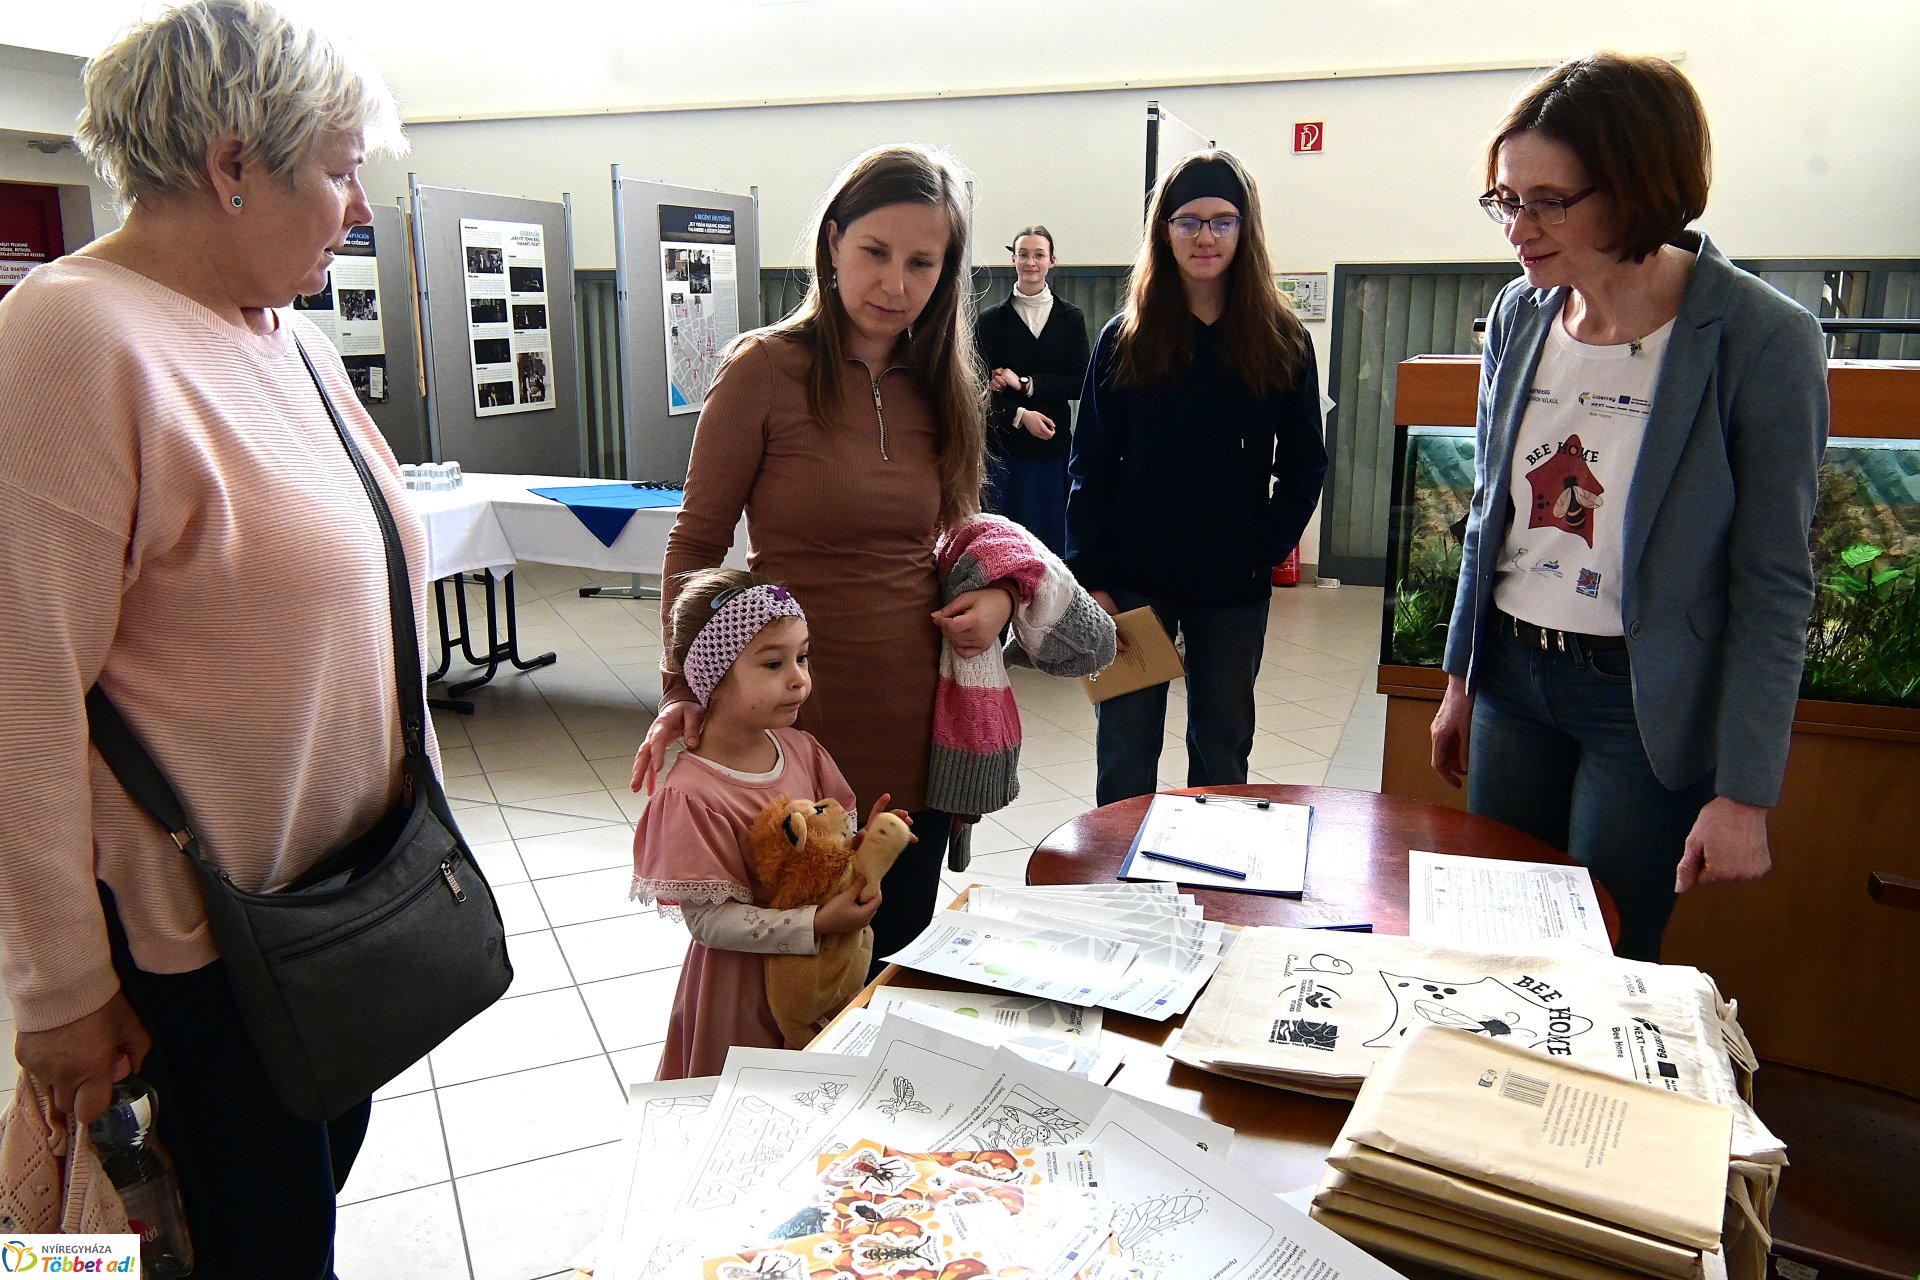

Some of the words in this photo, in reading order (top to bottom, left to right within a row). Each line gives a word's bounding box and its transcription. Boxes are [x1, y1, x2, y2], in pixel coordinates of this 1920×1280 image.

[1525, 443, 1551, 466] BEE
[1557, 441, 1599, 463] HOME
[1513, 975, 1563, 1002] BEE
[1547, 1007, 1572, 1055] HOME
[1612, 1026, 1621, 1040] Bee
[1634, 1025, 1646, 1044] NEXT
[1614, 1041, 1624, 1058] Home
